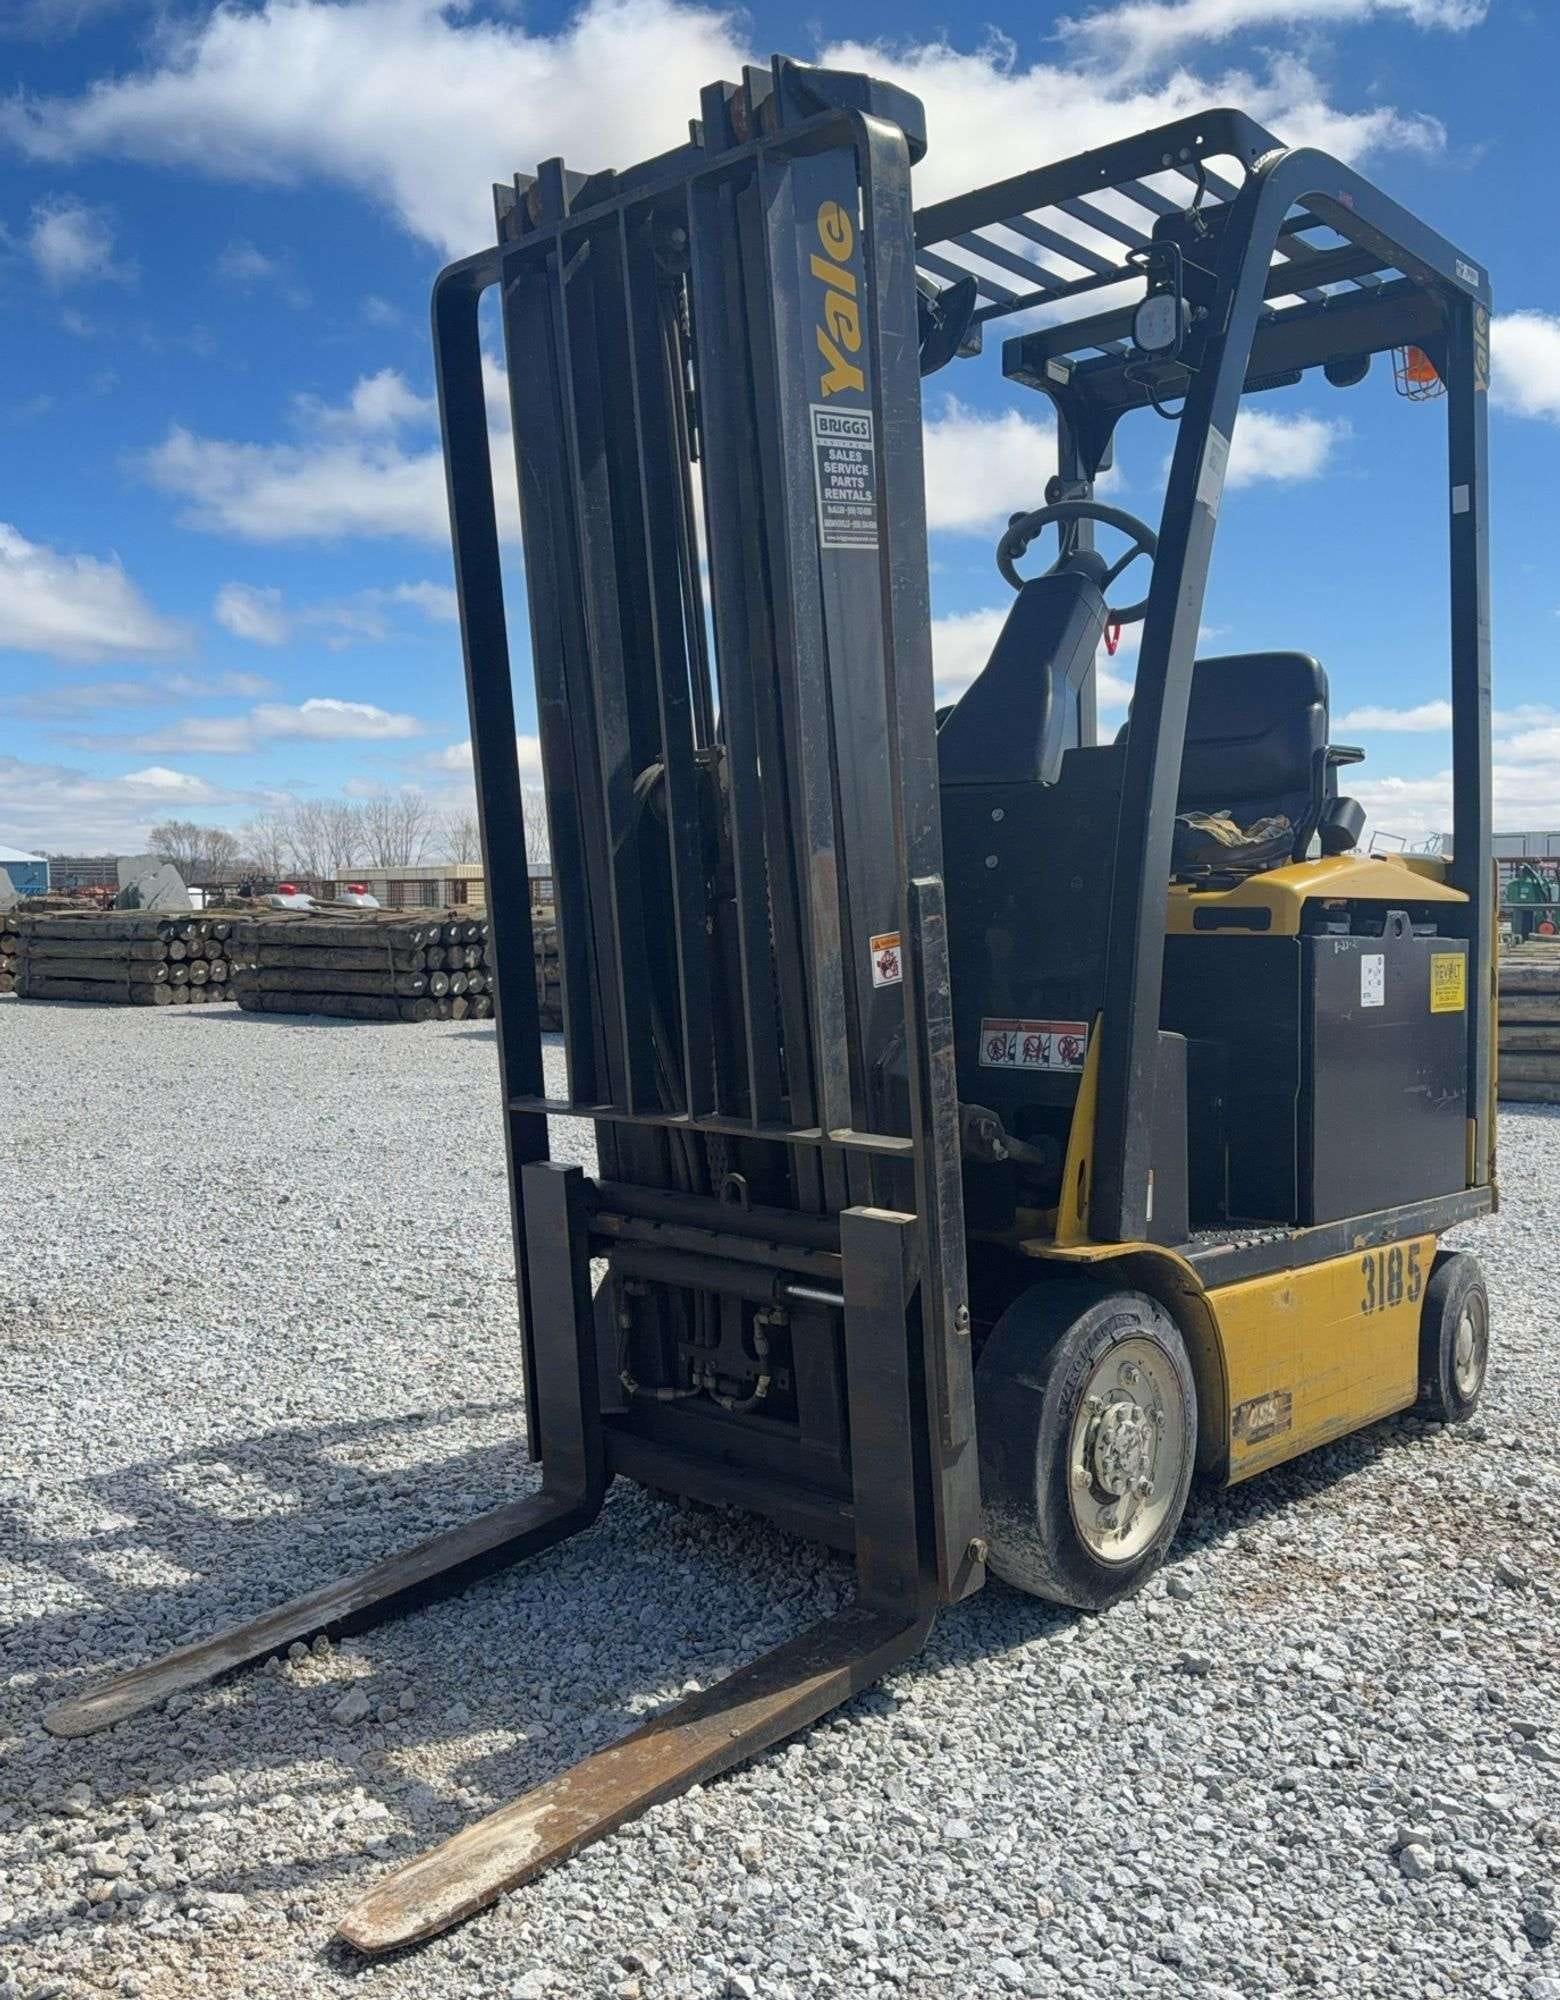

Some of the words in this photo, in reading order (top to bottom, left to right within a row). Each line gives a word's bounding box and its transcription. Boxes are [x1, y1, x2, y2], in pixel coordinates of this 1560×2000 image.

[810, 200, 864, 398] Yale
[1473, 304, 1489, 391] Yale
[819, 417, 867, 435] BRIGGS
[828, 449, 863, 462] SALES
[824, 462, 869, 475] SERVICE
[830, 476, 865, 488] PARTS
[824, 488, 872, 501] RENTALS
[1361, 1243, 1422, 1316] 3185
